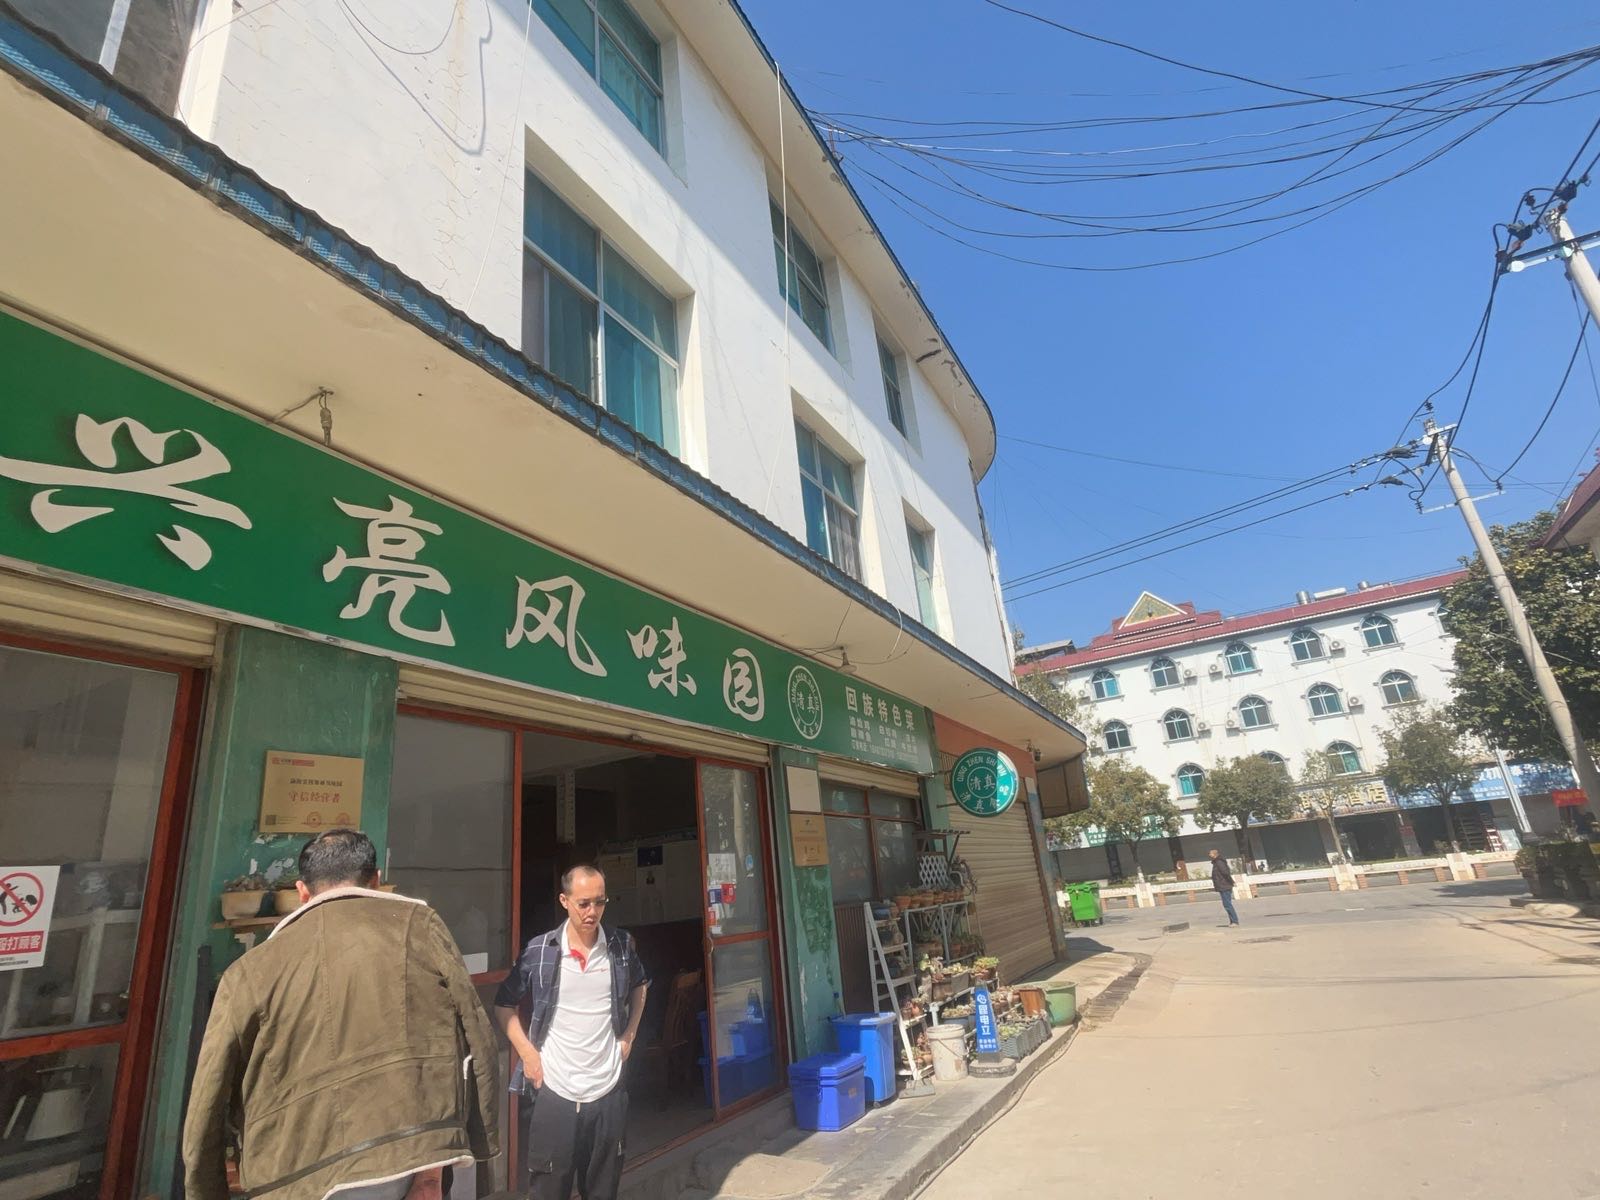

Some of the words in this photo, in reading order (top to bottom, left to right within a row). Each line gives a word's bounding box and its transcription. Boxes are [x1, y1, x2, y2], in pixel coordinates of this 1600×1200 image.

[0, 413, 765, 722] 兴亮风味园
[845, 686, 915, 730] 回族特色菜
[957, 766, 968, 782] QING
[966, 756, 983, 767] ZHEN
[970, 774, 995, 790] 清真
